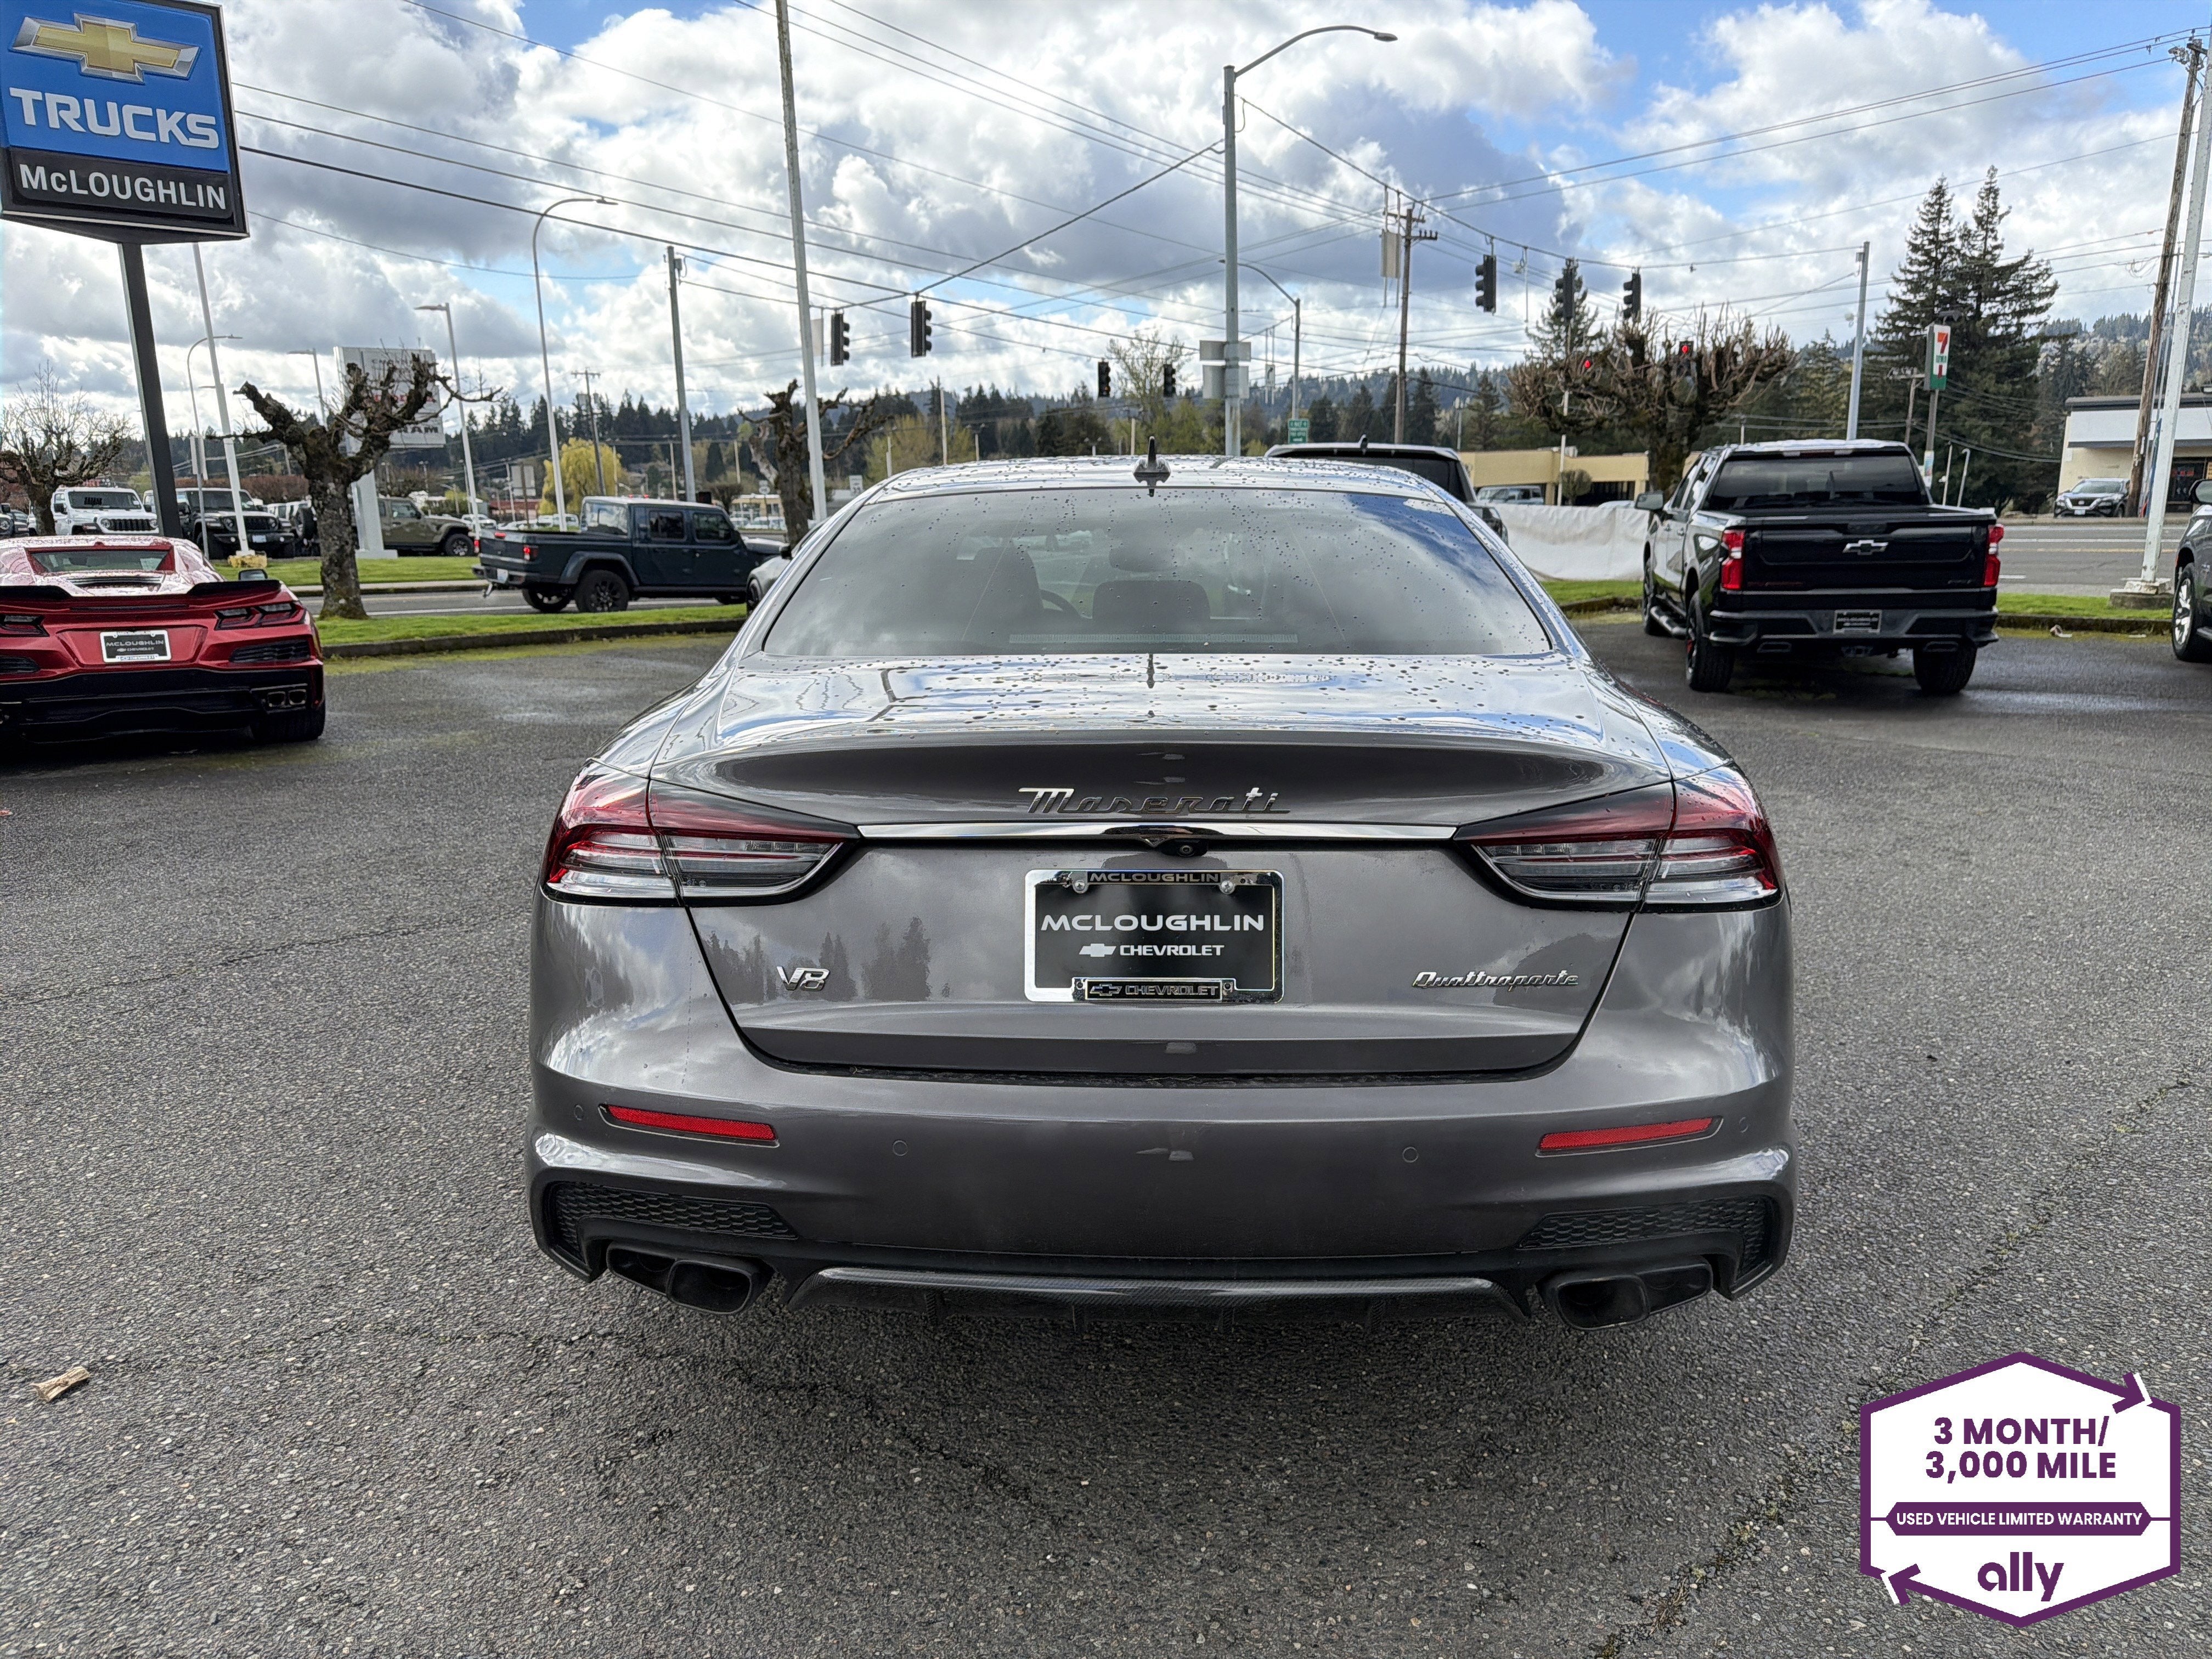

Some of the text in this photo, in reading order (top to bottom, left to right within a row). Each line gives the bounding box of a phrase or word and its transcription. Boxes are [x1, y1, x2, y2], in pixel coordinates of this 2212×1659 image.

[9, 87, 219, 149] TRUCKS
[19, 163, 227, 210] McLOUGHLIN
[1018, 787, 1291, 815] Maserati
[1089, 872, 1221, 884] MCLOUGHLIN
[1041, 915, 1265, 932] MCLOUGHLIN
[1119, 945, 1225, 956] CHEVROLET
[776, 966, 830, 991] V8
[1412, 970, 1579, 992] Quattroporte
[1125, 985, 1218, 997] CHEVROLET
